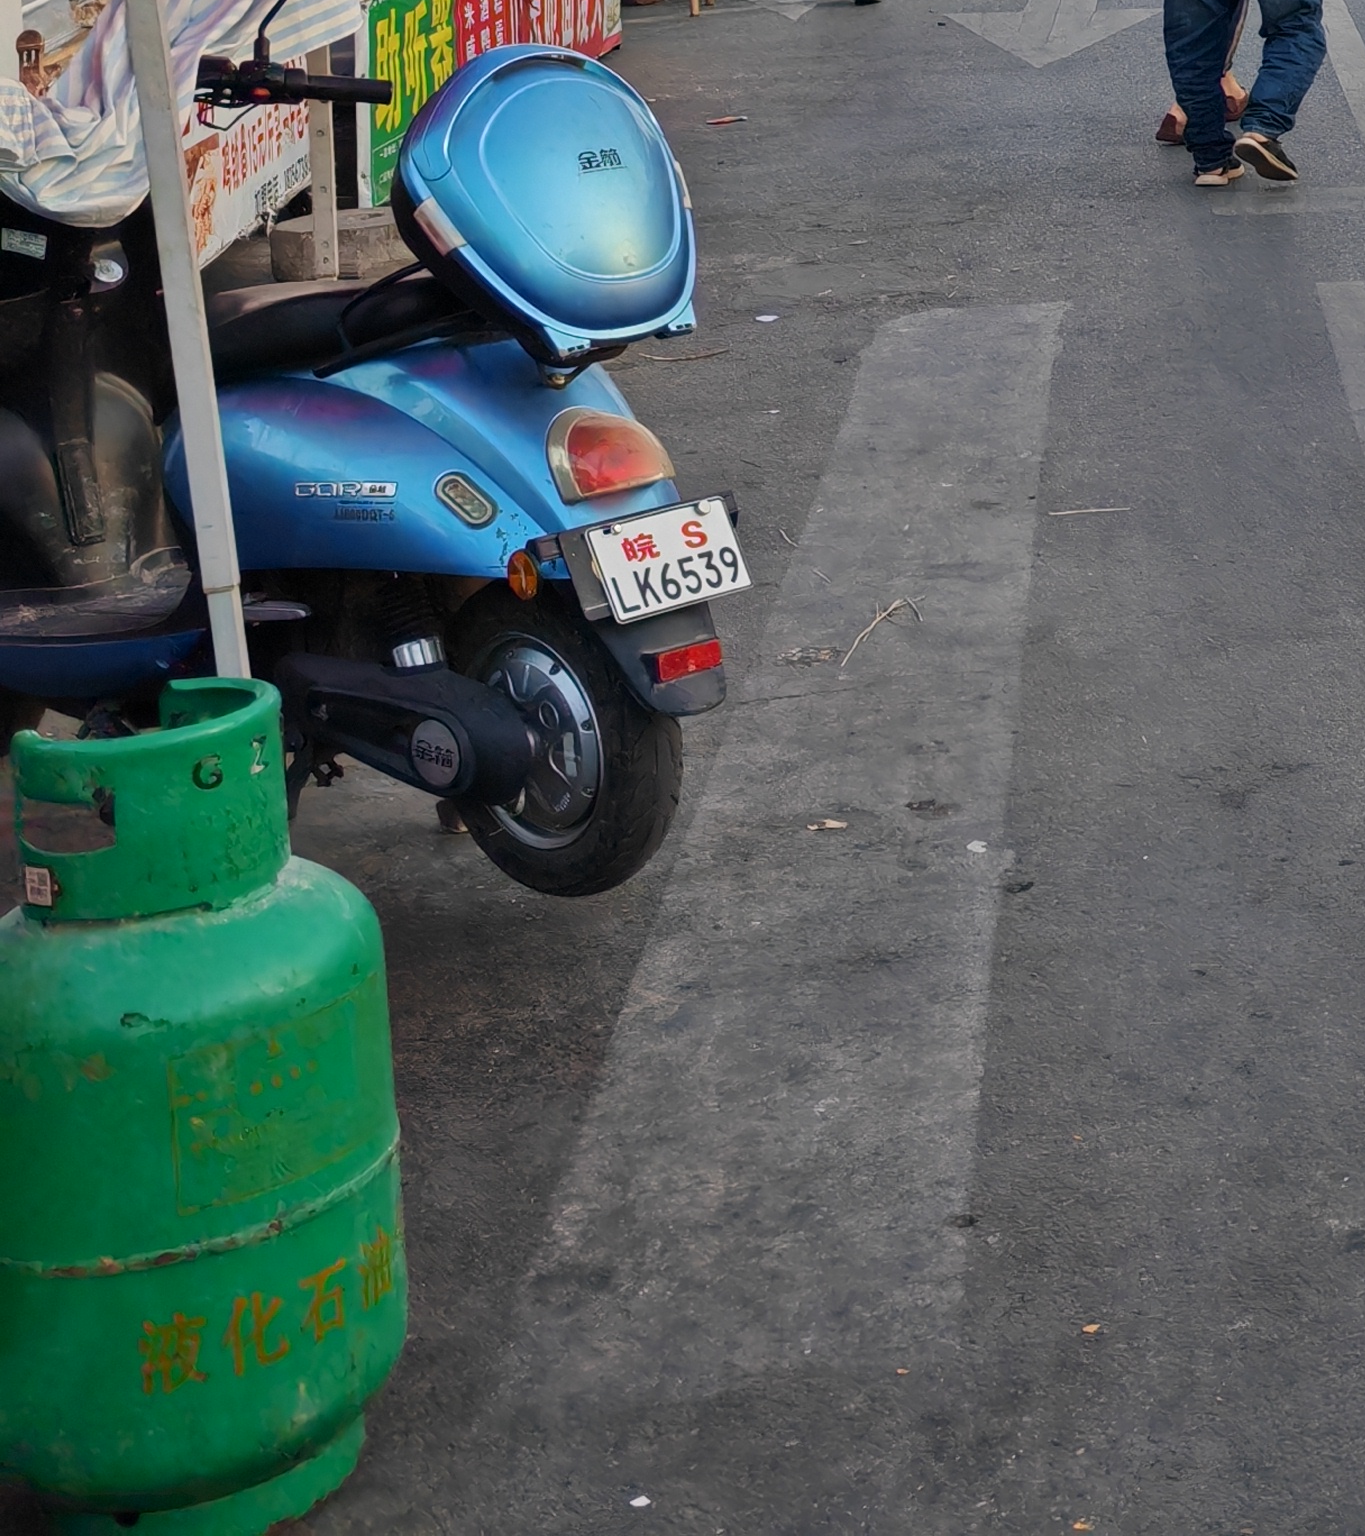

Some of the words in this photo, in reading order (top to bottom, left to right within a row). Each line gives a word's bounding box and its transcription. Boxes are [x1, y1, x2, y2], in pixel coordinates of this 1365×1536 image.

[620, 532, 661, 563] 皖
[681, 520, 709, 549] S
[611, 546, 739, 613] LK6539
